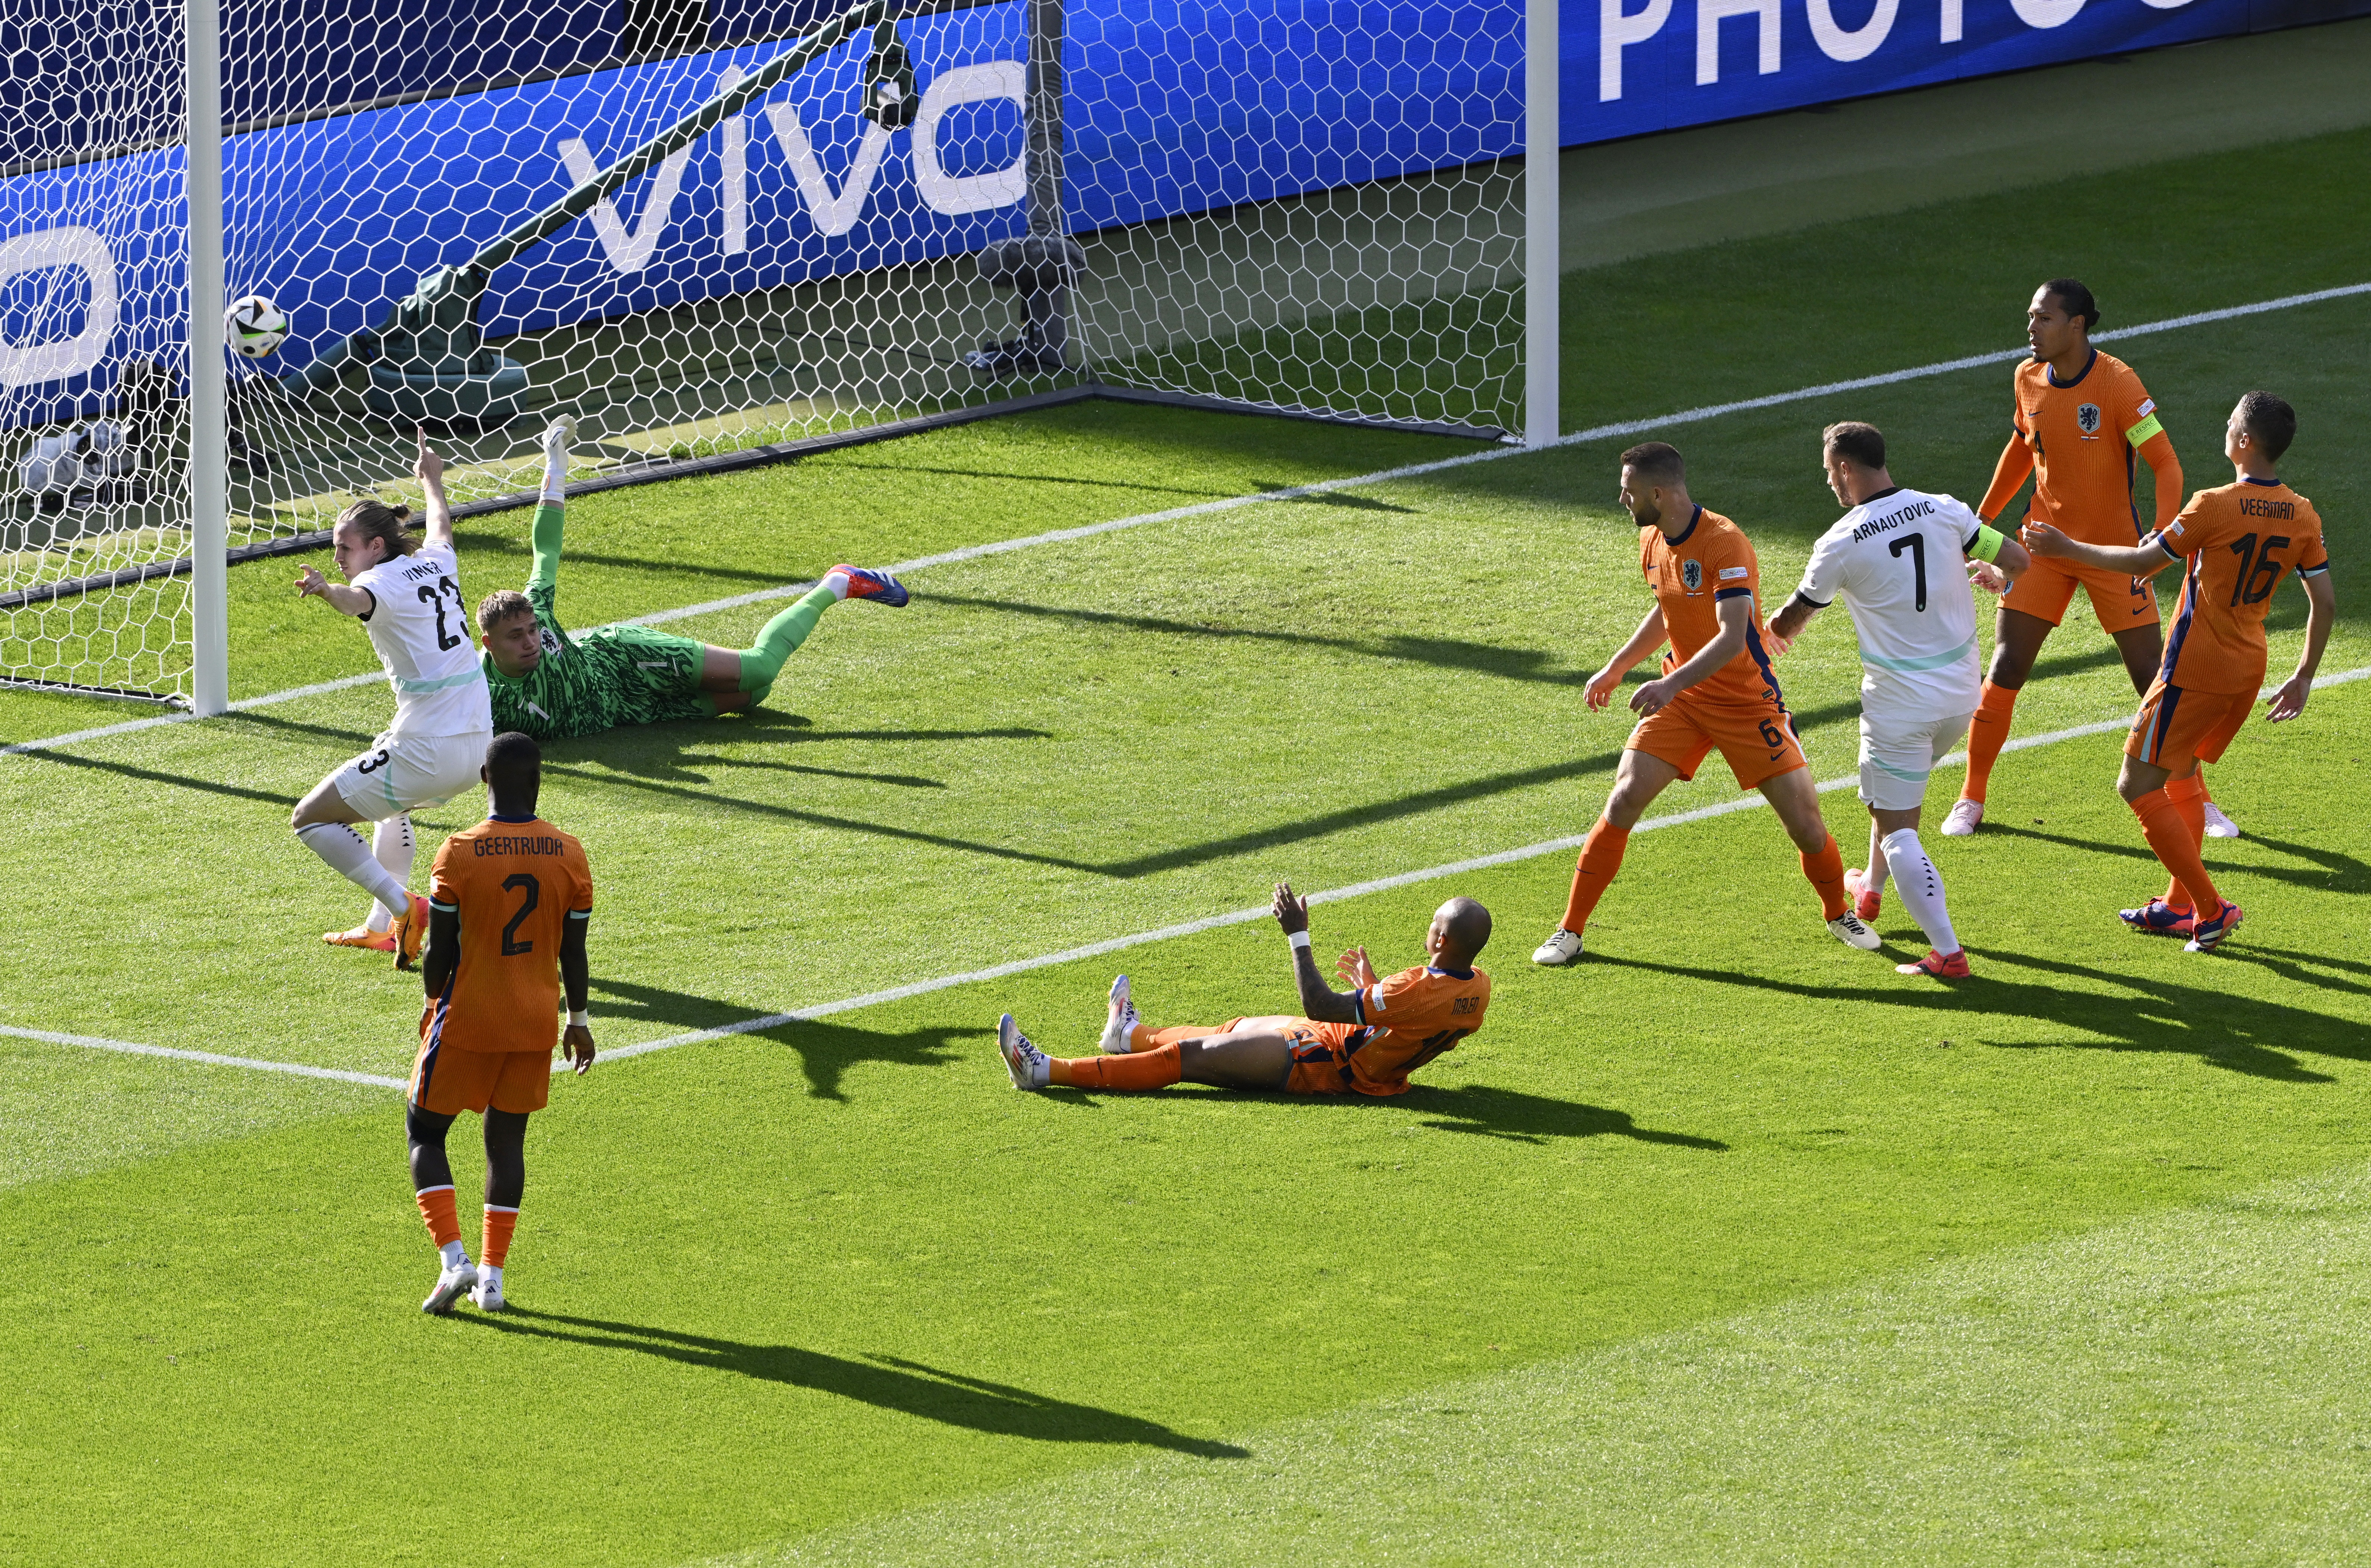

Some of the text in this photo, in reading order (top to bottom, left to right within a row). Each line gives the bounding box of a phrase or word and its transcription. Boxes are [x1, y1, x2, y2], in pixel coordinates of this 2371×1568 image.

[2135, 418, 2155, 434] RESPECT
[2034, 430, 2046, 460] 4
[1853, 501, 1935, 543] ARNAUTOVIC
[2240, 498, 2294, 520] VEERMAN
[1888, 532, 1927, 612] 7
[2230, 533, 2291, 607] 16
[1758, 718, 1783, 748] 6
[474, 836, 564, 857] GEERTRUIDA
[500, 873, 539, 956] 2
[1451, 997, 1479, 1015] MALEN
